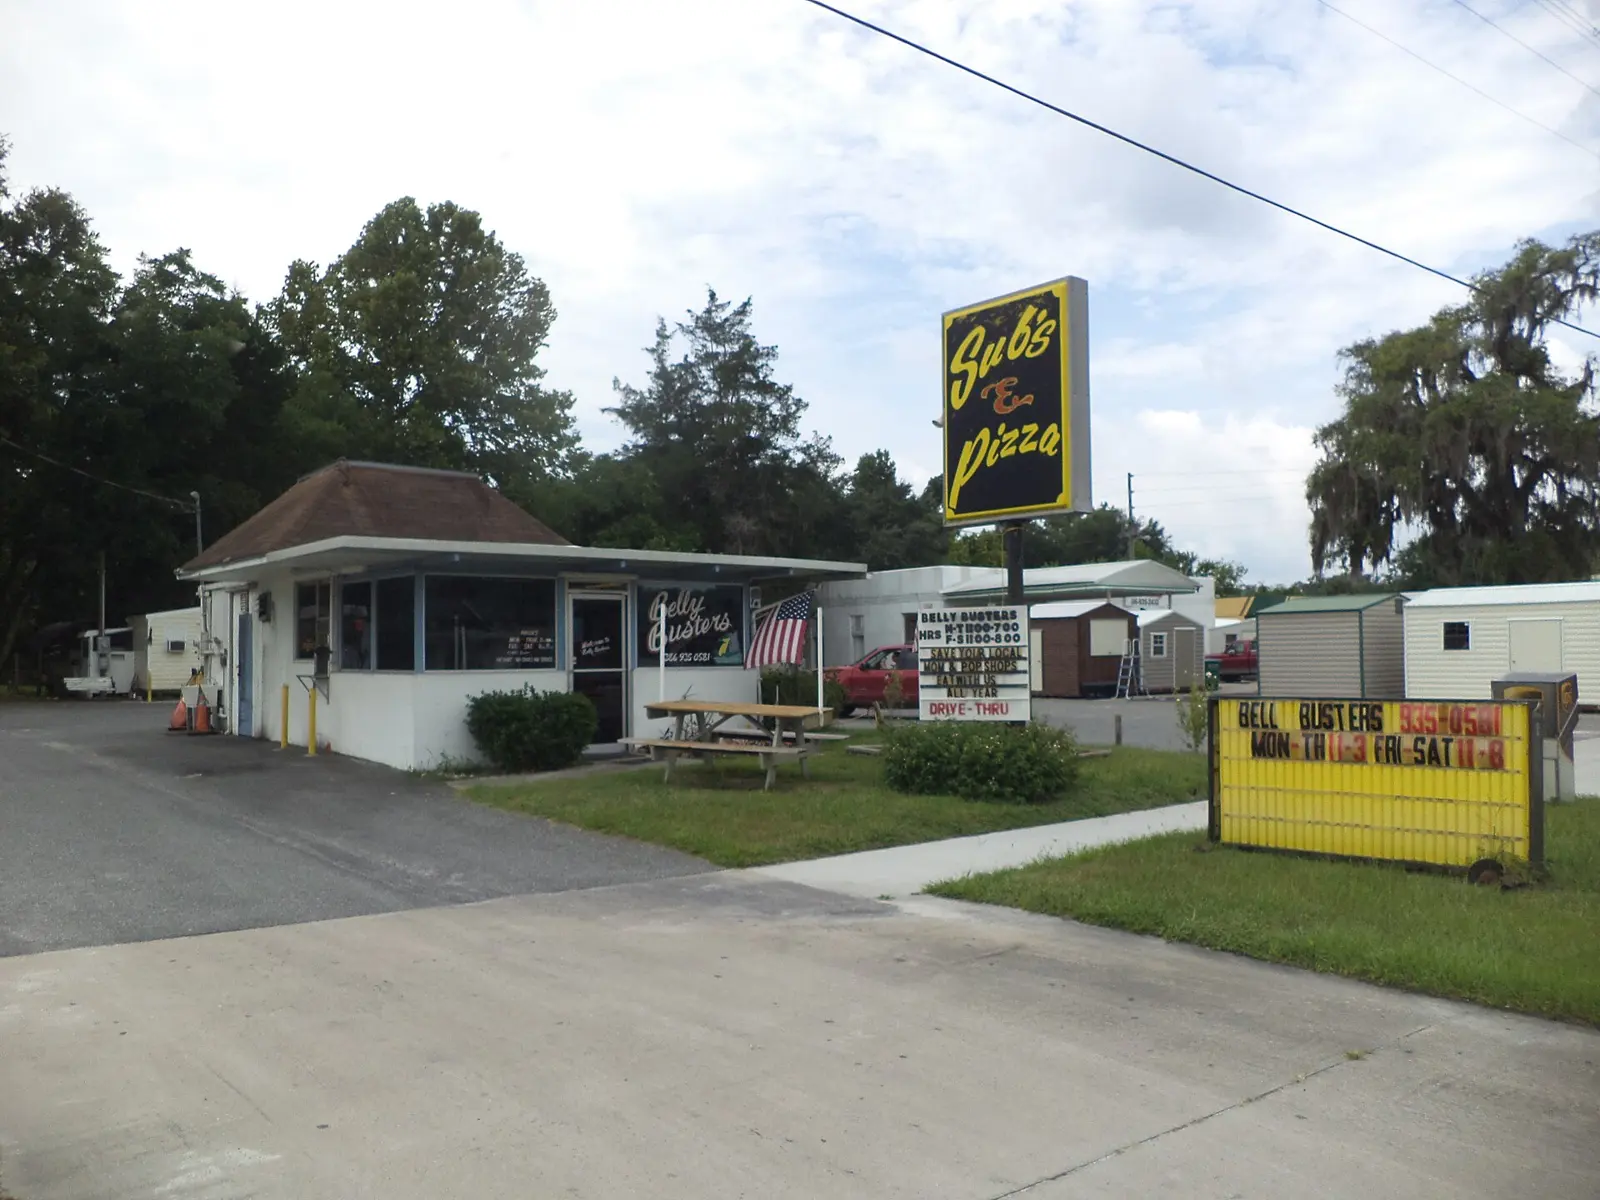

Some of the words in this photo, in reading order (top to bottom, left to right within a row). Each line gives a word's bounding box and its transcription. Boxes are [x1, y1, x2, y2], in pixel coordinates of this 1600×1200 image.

[950, 304, 1057, 410] Sub's
[949, 422, 1061, 510] Pizza
[649, 590, 706, 621] Belly
[921, 612, 957, 623] BELLY
[961, 610, 1018, 622] BUSTERS
[648, 612, 732, 652] Busters
[919, 630, 941, 640] HRS
[693, 653, 711, 662] 0581
[930, 648, 956, 659] SAVE
[959, 648, 985, 659] YOUR
[988, 647, 1022, 659] LOCAL
[949, 661, 957, 671] &
[961, 661, 981, 672] POP
[983, 660, 1018, 671] SHOPS
[956, 674, 980, 685] WITH
[983, 674, 996, 685] US
[947, 688, 964, 698] ALL
[972, 688, 998, 698] YEAR
[1238, 702, 1278, 729] BELL
[1299, 703, 1384, 732] BUSTERS
[1400, 704, 1501, 736] 935-0581
